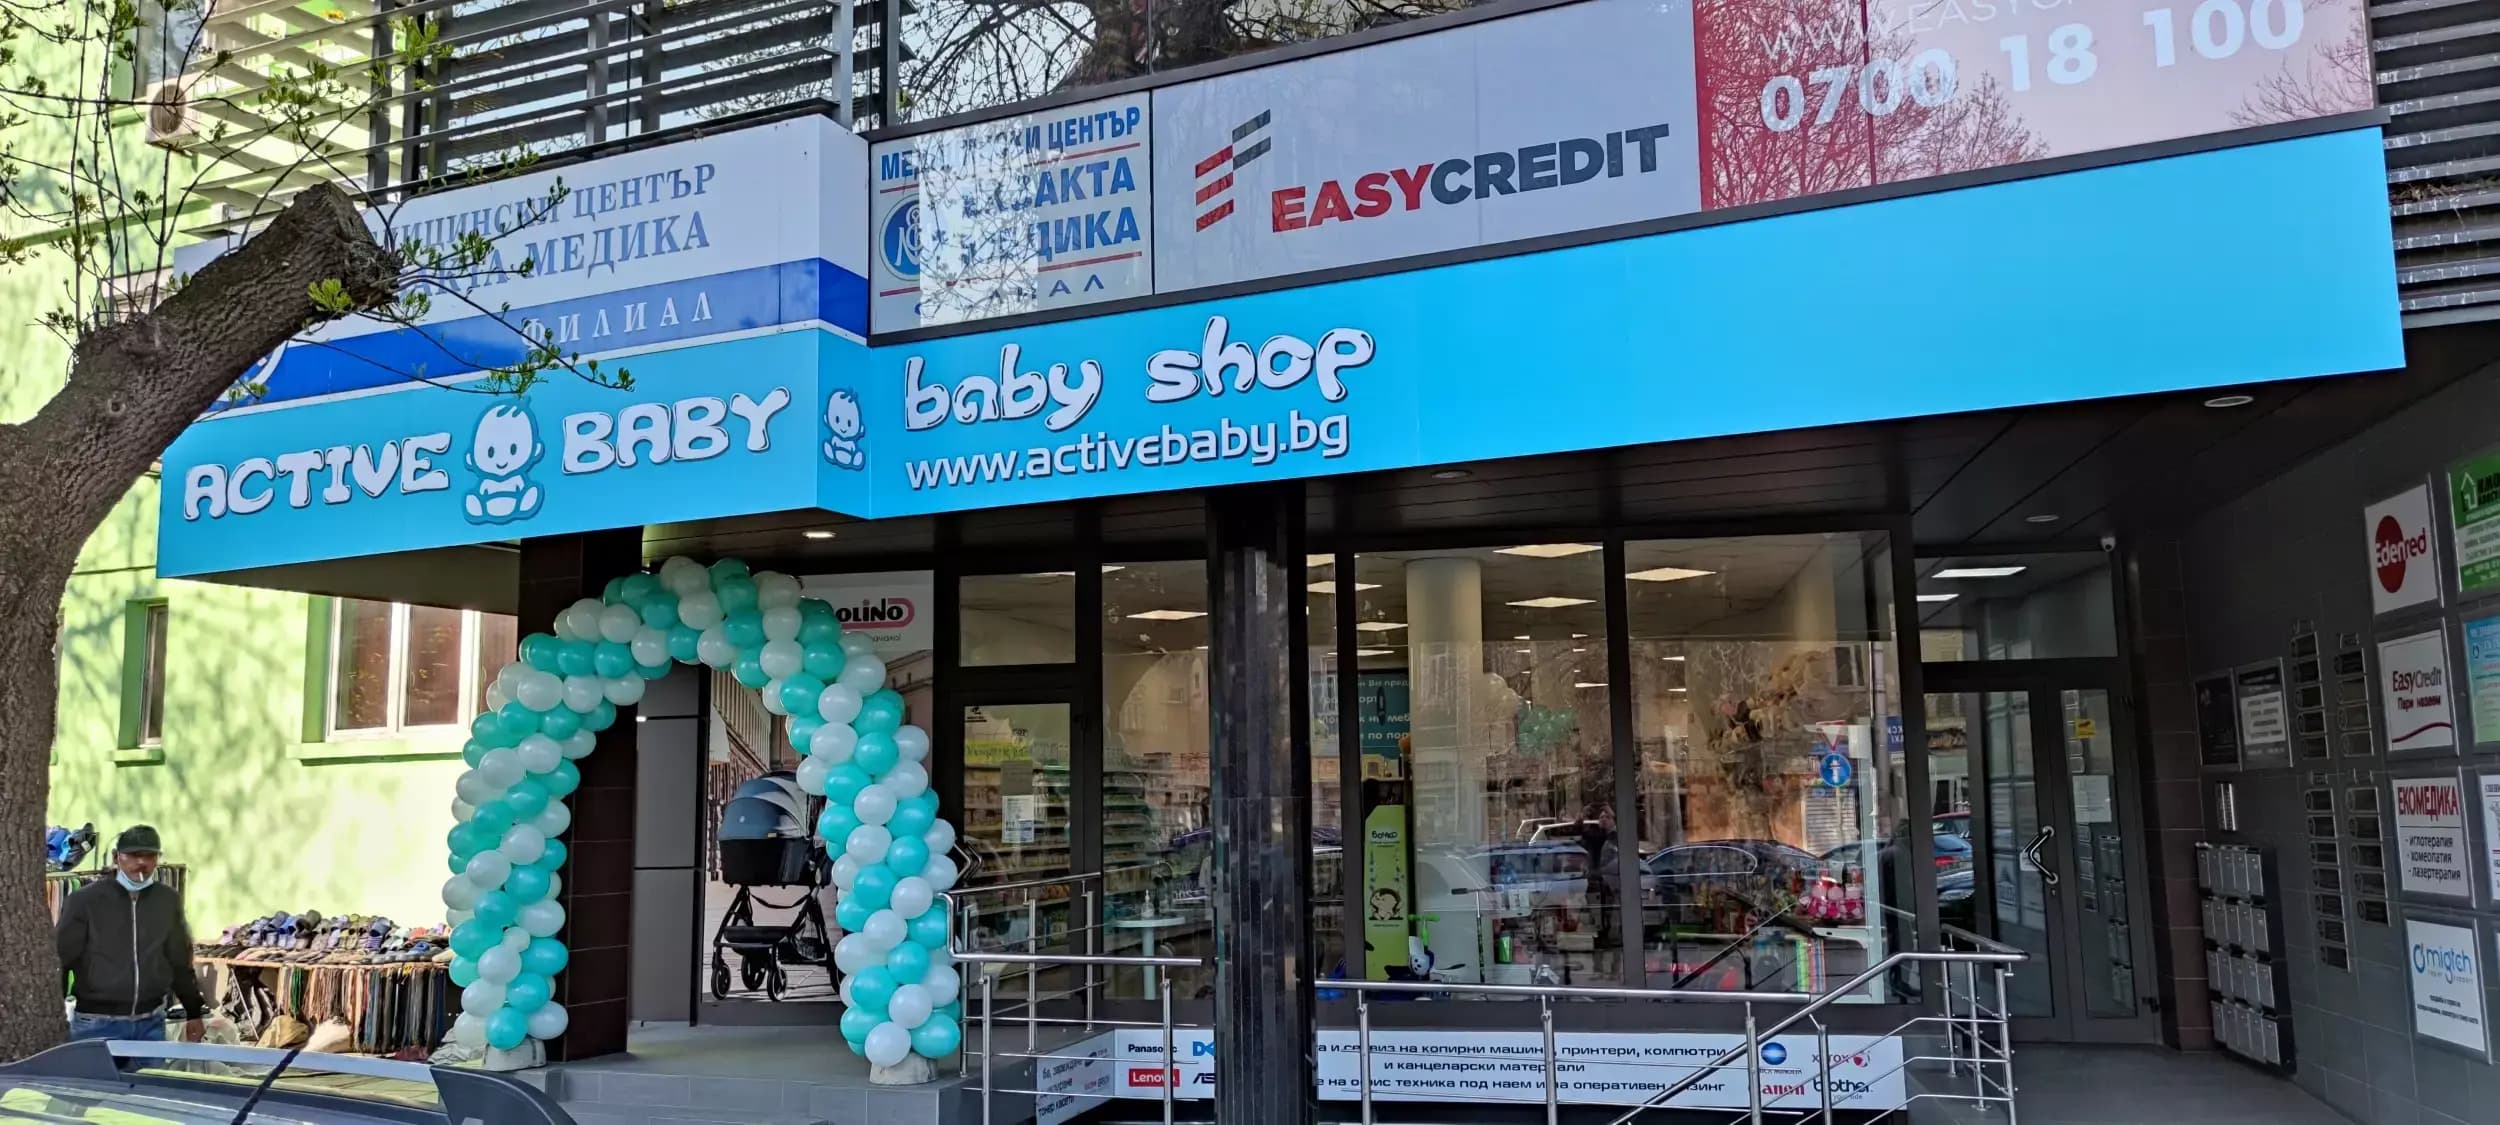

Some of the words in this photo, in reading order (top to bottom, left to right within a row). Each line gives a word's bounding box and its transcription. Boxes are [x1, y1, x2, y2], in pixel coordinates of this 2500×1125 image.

[1760, 48, 1954, 132] 0700
[2000, 22, 2099, 93] 18
[2143, 0, 2305, 69] 100
[1049, 106, 1141, 154] ЦЕНТЪР
[573, 163, 716, 222] ЦЕНТЪР
[1271, 123, 1670, 233] EASYCREDIT
[524, 210, 711, 279] МЕДИКА
[520, 291, 714, 350] ФИЛИАЛ
[905, 343, 1104, 432] baby
[1145, 315, 1376, 403] shop
[182, 431, 453, 522] ACTIVE
[560, 385, 792, 476] BABY
[905, 409, 1351, 491] www.activebaby.bg
[2376, 527, 2427, 569] Edenred
[2392, 666, 2442, 695] EasyCredit
[2398, 785, 2459, 822] ЕКОМЕДИКА
[1128, 1043, 1178, 1053] Panasoc
[1331, 1044, 1340, 1052] и
[1343, 1044, 1396, 1053] севиз
[1400, 1045, 1418, 1053] на
[1422, 1046, 1486, 1058] копирни
[1561, 1047, 1640, 1058] принтери,
[1644, 1047, 1727, 1058] компютри
[1384, 1062, 1393, 1070] и
[1397, 1062, 1496, 1073] канцеларски
[1500, 1063, 1585, 1074] матерали
[1328, 1078, 1347, 1087] на
[1351, 1078, 1391, 1088] оис
[1395, 1079, 1456, 1088] техника
[1460, 1080, 1489, 1090] под
[1493, 1080, 1532, 1089] наем
[1573, 1080, 1666, 1092] оперативен
[1760, 1083, 1805, 1096] anon
[1813, 1077, 1870, 1094] bother
